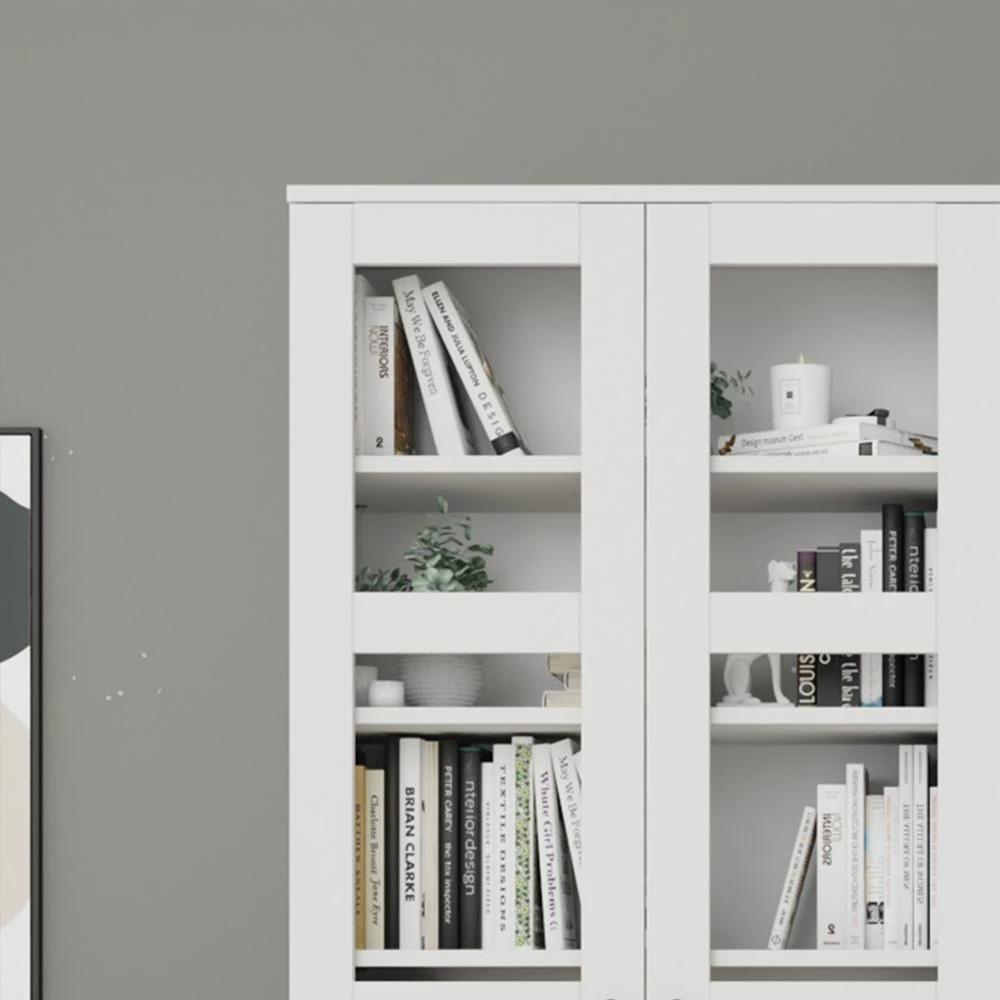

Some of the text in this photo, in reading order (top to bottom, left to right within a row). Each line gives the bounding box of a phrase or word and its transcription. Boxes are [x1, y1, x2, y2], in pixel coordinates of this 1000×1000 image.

[379, 325, 389, 379] INTERIORS
[403, 290, 438, 395] May We Be Forgiven
[431, 291, 480, 386] ELLEN AND JULIA LUPTON
[376, 437, 384, 448] 2
[799, 654, 816, 704] LOUIS
[444, 765, 453, 797] PETER
[564, 781, 577, 800] We
[370, 794, 380, 840] Charlotte
[444, 799, 453, 832] CAREY
[543, 820, 554, 849] Girl
[405, 787, 415, 902] BRIAN CLARKE
[444, 842, 453, 859] the
[463, 837, 477, 896] design
[443, 878, 453, 924] inspector
[546, 853, 558, 918] Problems
